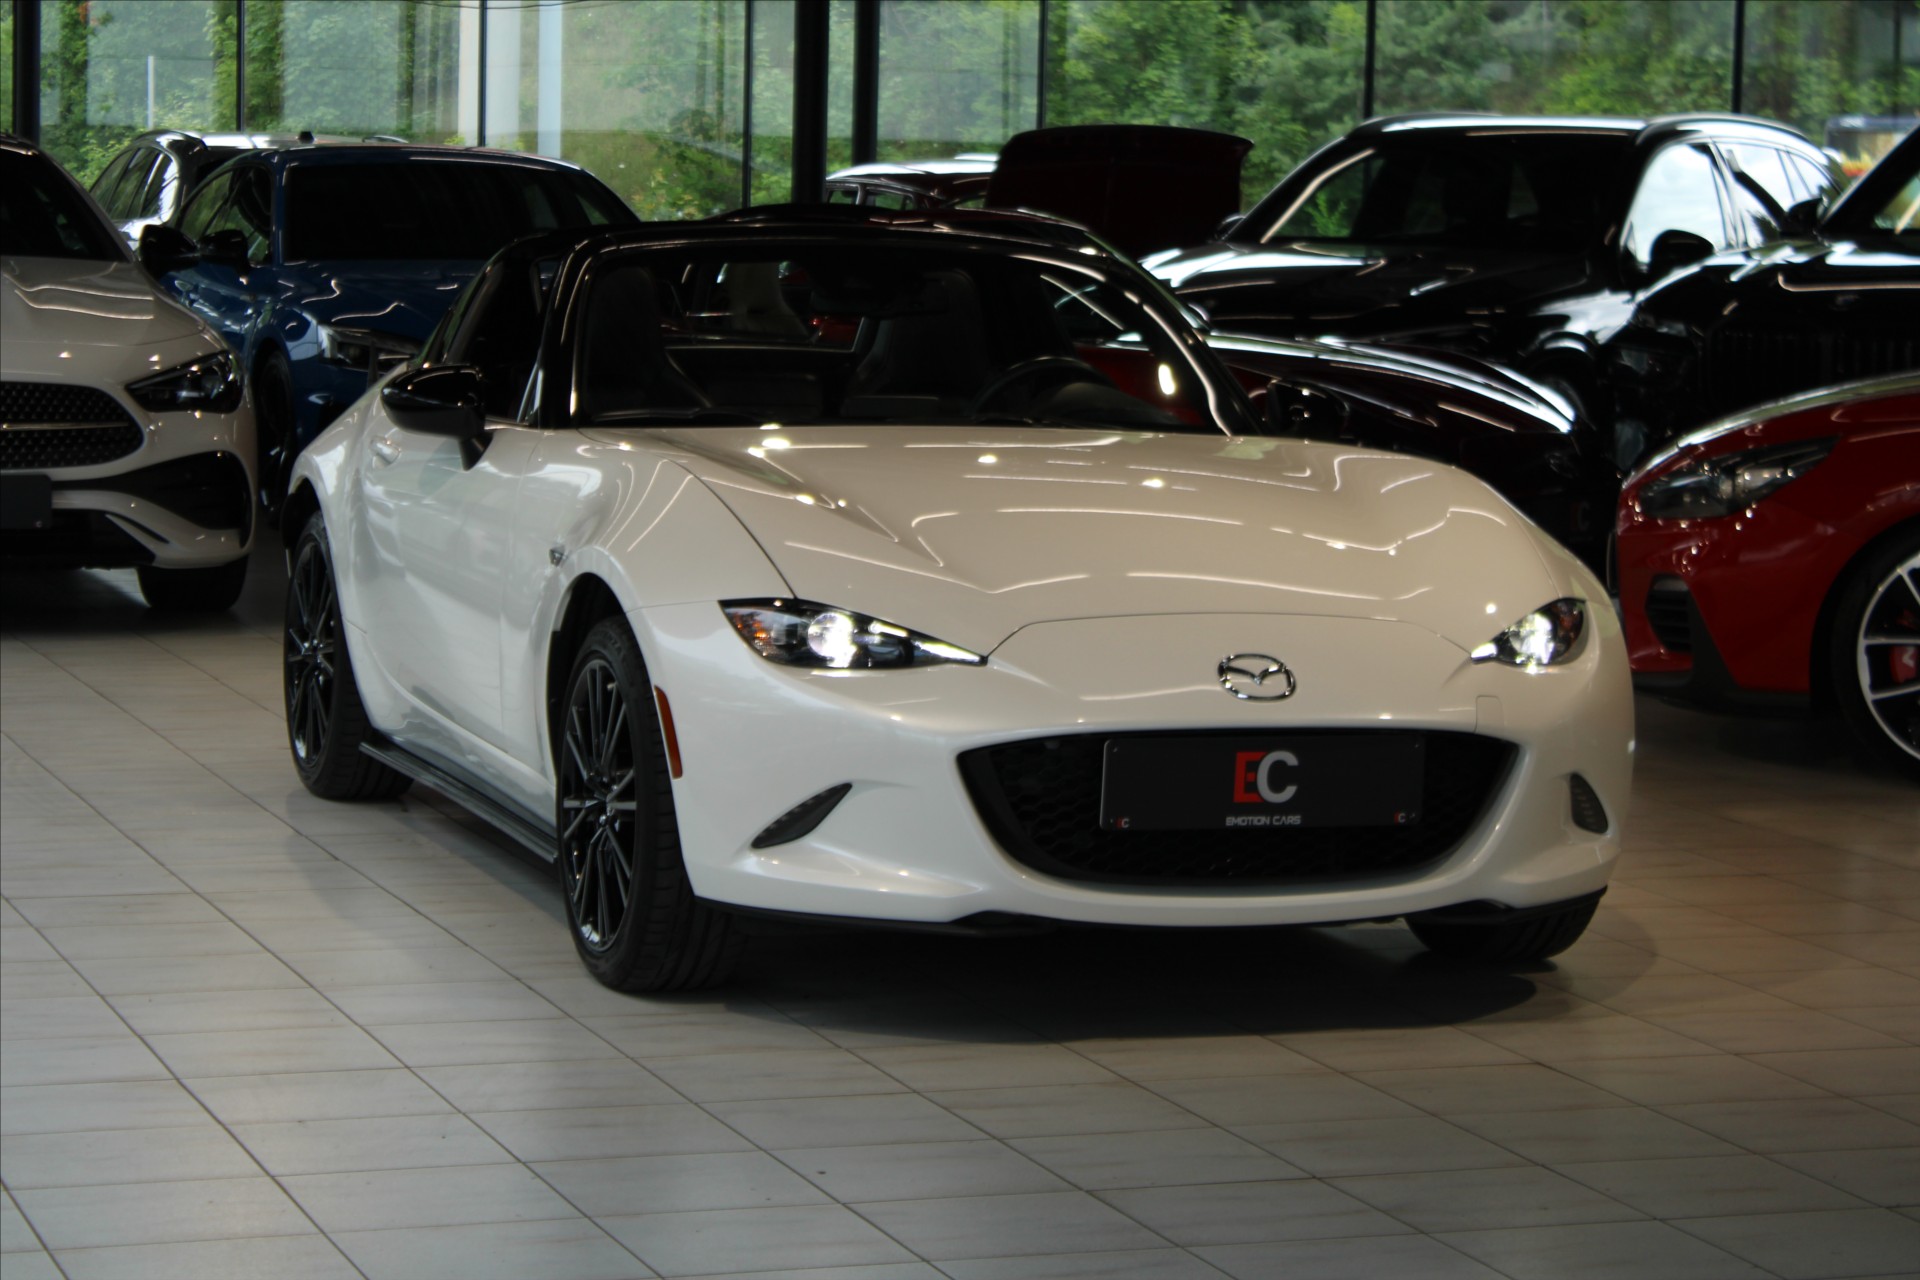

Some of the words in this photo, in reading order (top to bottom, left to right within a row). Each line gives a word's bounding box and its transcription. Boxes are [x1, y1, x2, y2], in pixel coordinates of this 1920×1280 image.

[1233, 750, 1299, 803] EC
[1226, 816, 1270, 826] EMOTION
[1272, 815, 1301, 825] CARS
